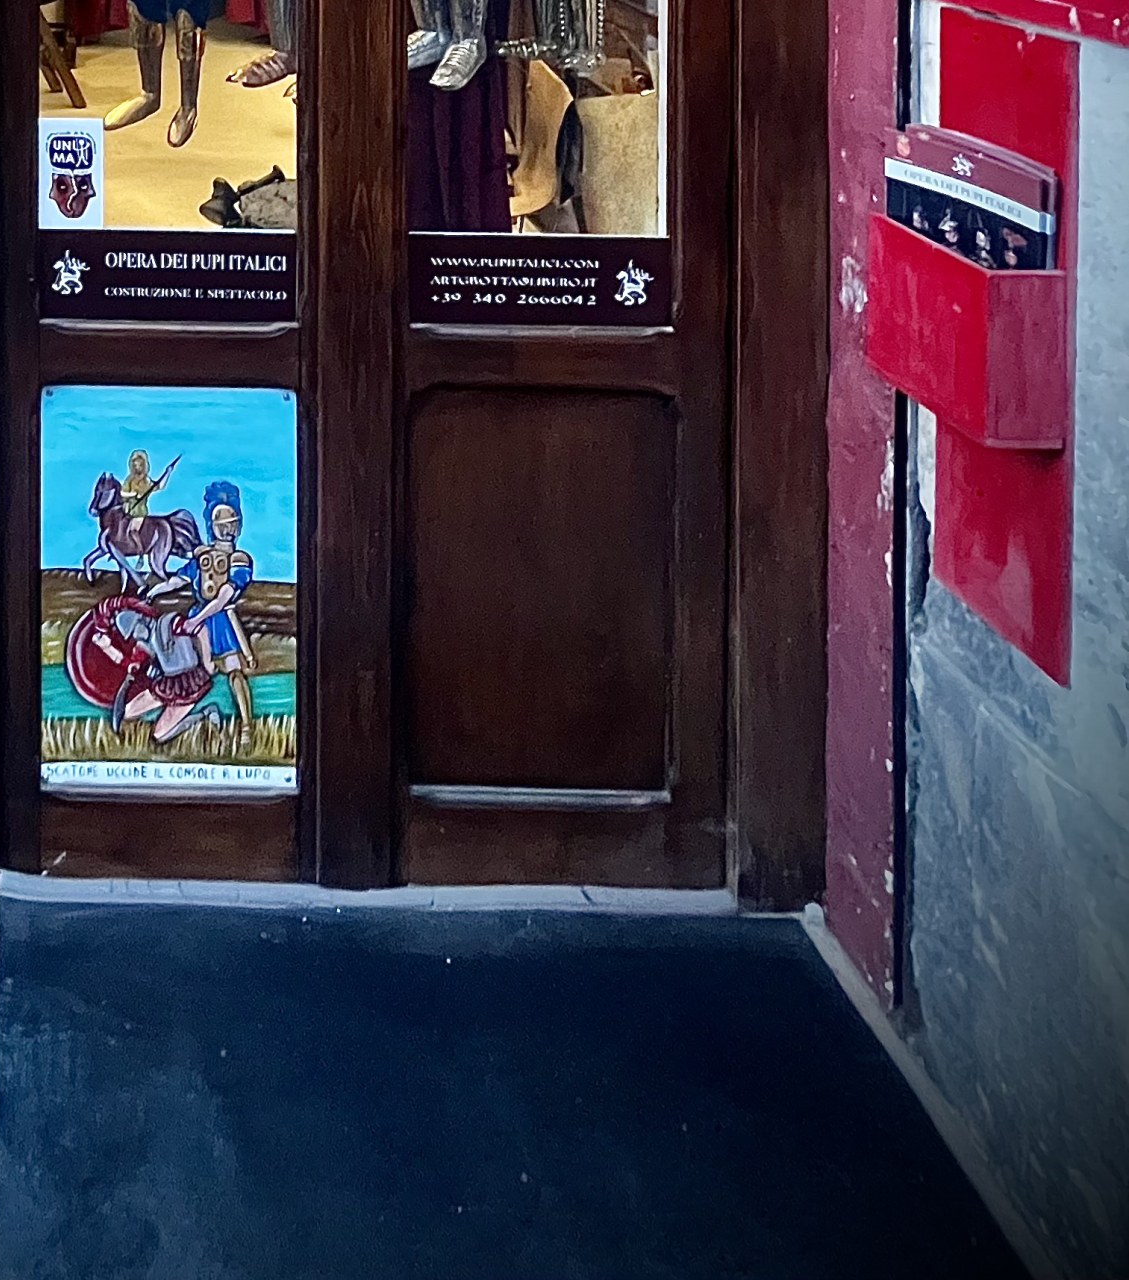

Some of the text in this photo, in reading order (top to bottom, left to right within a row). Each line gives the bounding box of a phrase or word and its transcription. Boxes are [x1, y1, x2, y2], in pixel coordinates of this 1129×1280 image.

[104, 252, 287, 272] OPERA DEI PUPI ITALICI
[104, 287, 288, 301] COSTRUZIONE E SPETTACOLO
[472, 292, 507, 304] 340
